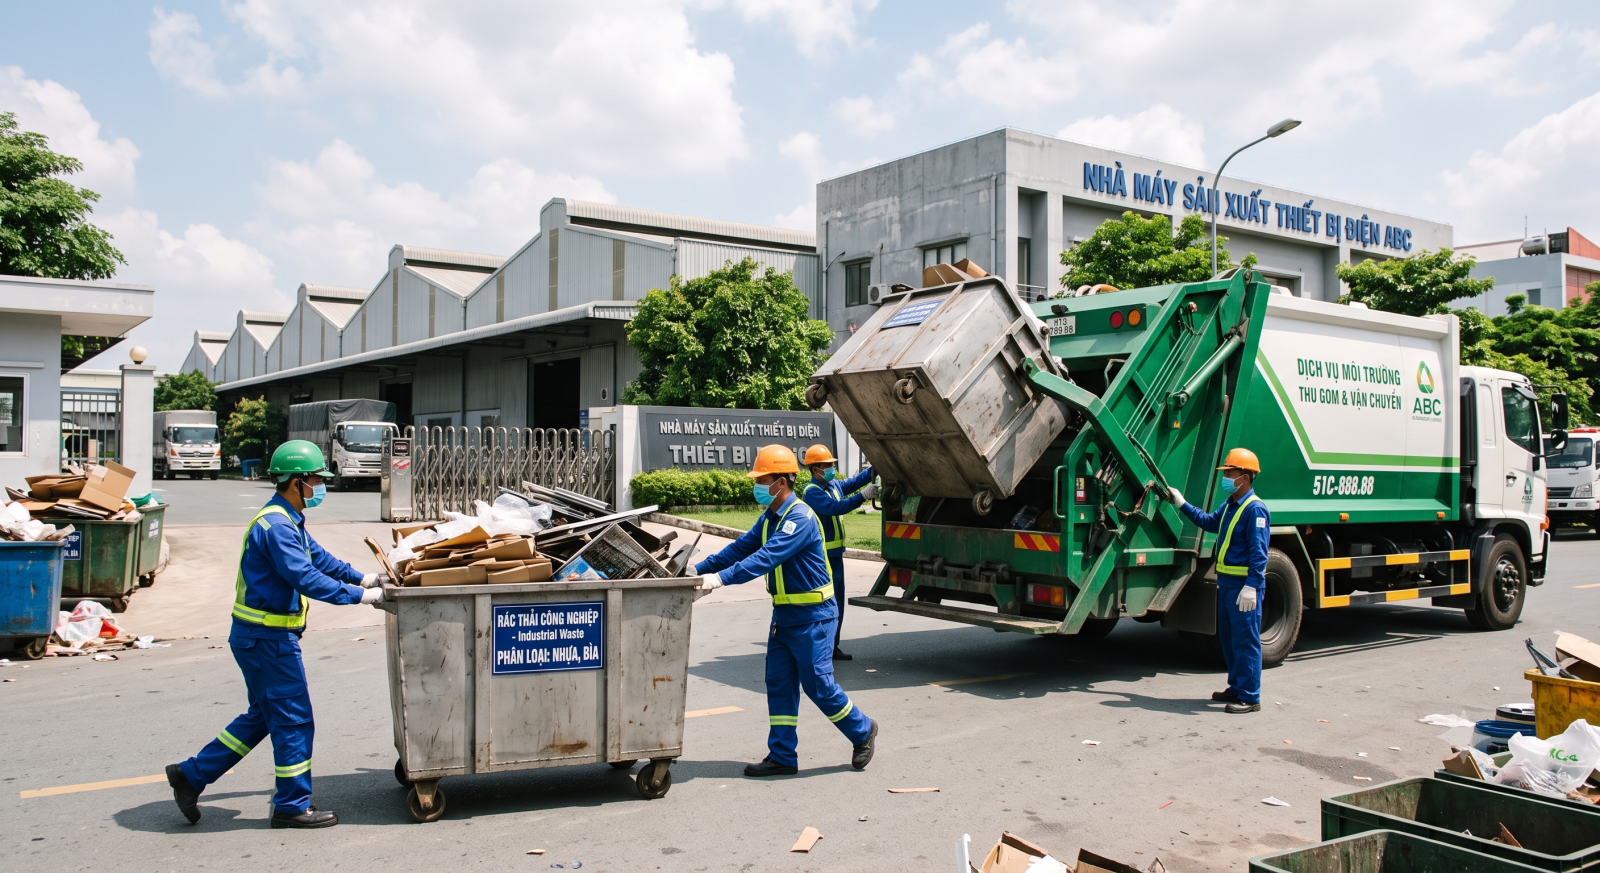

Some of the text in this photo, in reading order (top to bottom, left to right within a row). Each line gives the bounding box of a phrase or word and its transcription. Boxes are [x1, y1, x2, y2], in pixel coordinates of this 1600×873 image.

[1084, 161, 1127, 197] NHÀ
[1134, 170, 1177, 206] MÁY
[1225, 189, 1271, 225] XUẤT
[1275, 199, 1321, 234] THIẾT
[1326, 213, 1341, 243] BỊ
[1345, 214, 1380, 247] ĐIỆN
[1384, 225, 1412, 251] ABC
[1297, 358, 1323, 380] DỊCH
[1325, 361, 1339, 383] VỤ
[1342, 360, 1361, 382] MÔI
[1299, 386, 1317, 403] THU
[1320, 388, 1339, 405] GOM
[1342, 390, 1348, 406] &
[1350, 388, 1368, 410] VẬN
[1413, 397, 1442, 416] ABC
[660, 418, 682, 434] NHÀ
[684, 418, 706, 435] MÁY
[708, 418, 728, 435] SẢN
[730, 419, 755, 436] XUẤT
[758, 420, 784, 437] THIẾT
[787, 425, 797, 439] BỊ
[669, 438, 727, 464] THIẾT
[733, 446, 751, 467] BỊ
[1312, 475, 1375, 495] 51C-888.88
[497, 608, 599, 628] RÁC THẢI CÔNG NGHIỆP
[518, 629, 557, 641] Industrial
[559, 629, 584, 640] Waste
[497, 642, 599, 666] PHÂN LOẠI: NHỰA, BÌA
